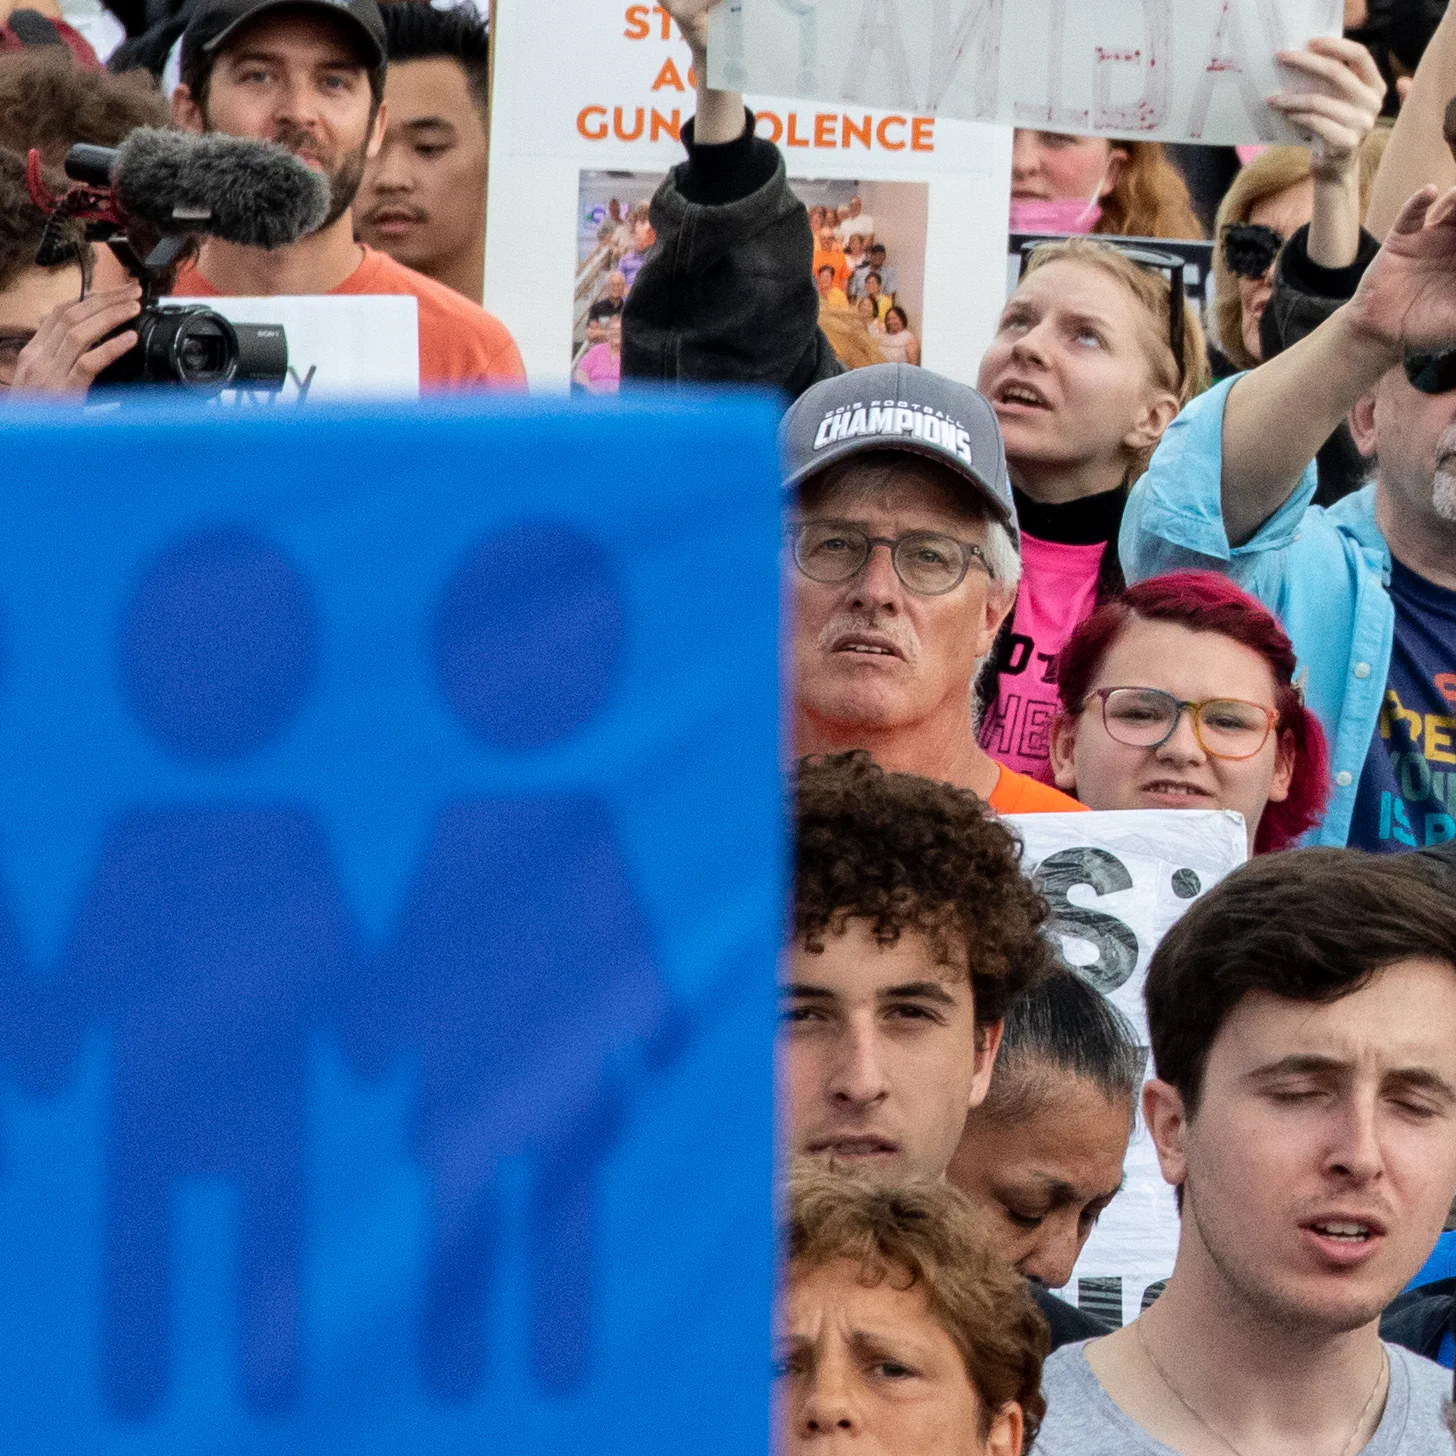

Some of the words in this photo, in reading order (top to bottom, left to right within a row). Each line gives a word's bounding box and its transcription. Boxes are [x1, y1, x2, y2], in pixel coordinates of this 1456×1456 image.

[575, 104, 682, 143] GUN
[755, 110, 936, 153] OLENCE
[813, 406, 974, 466] CHAMPIONS
[870, 399, 966, 429] FOOTBALL
